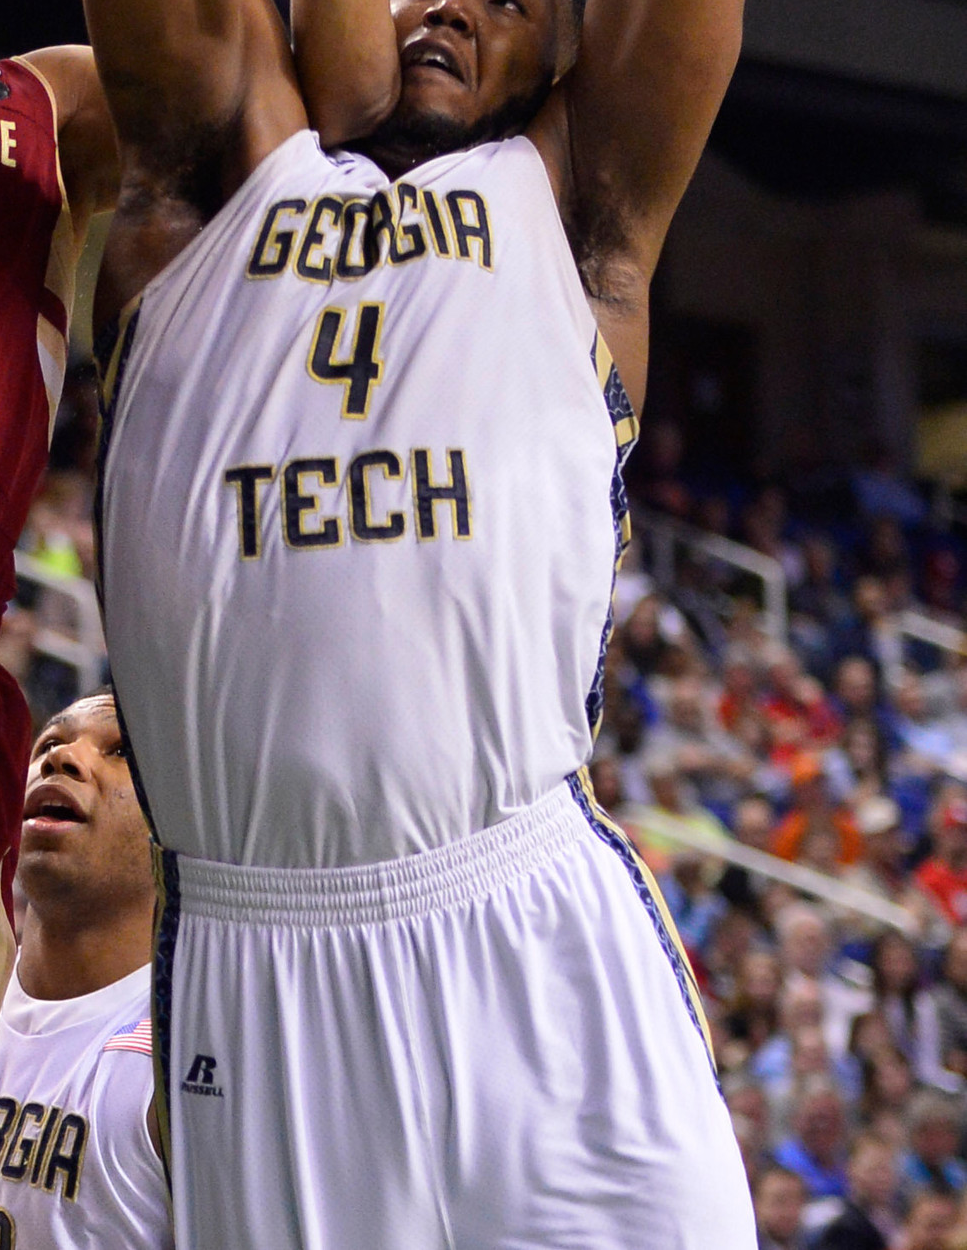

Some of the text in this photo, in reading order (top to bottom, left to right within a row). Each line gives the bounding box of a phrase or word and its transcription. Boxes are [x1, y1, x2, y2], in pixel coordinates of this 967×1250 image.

[245, 181, 495, 285] GEORGIA
[306, 300, 386, 421] 4
[223, 447, 474, 562] TECH
